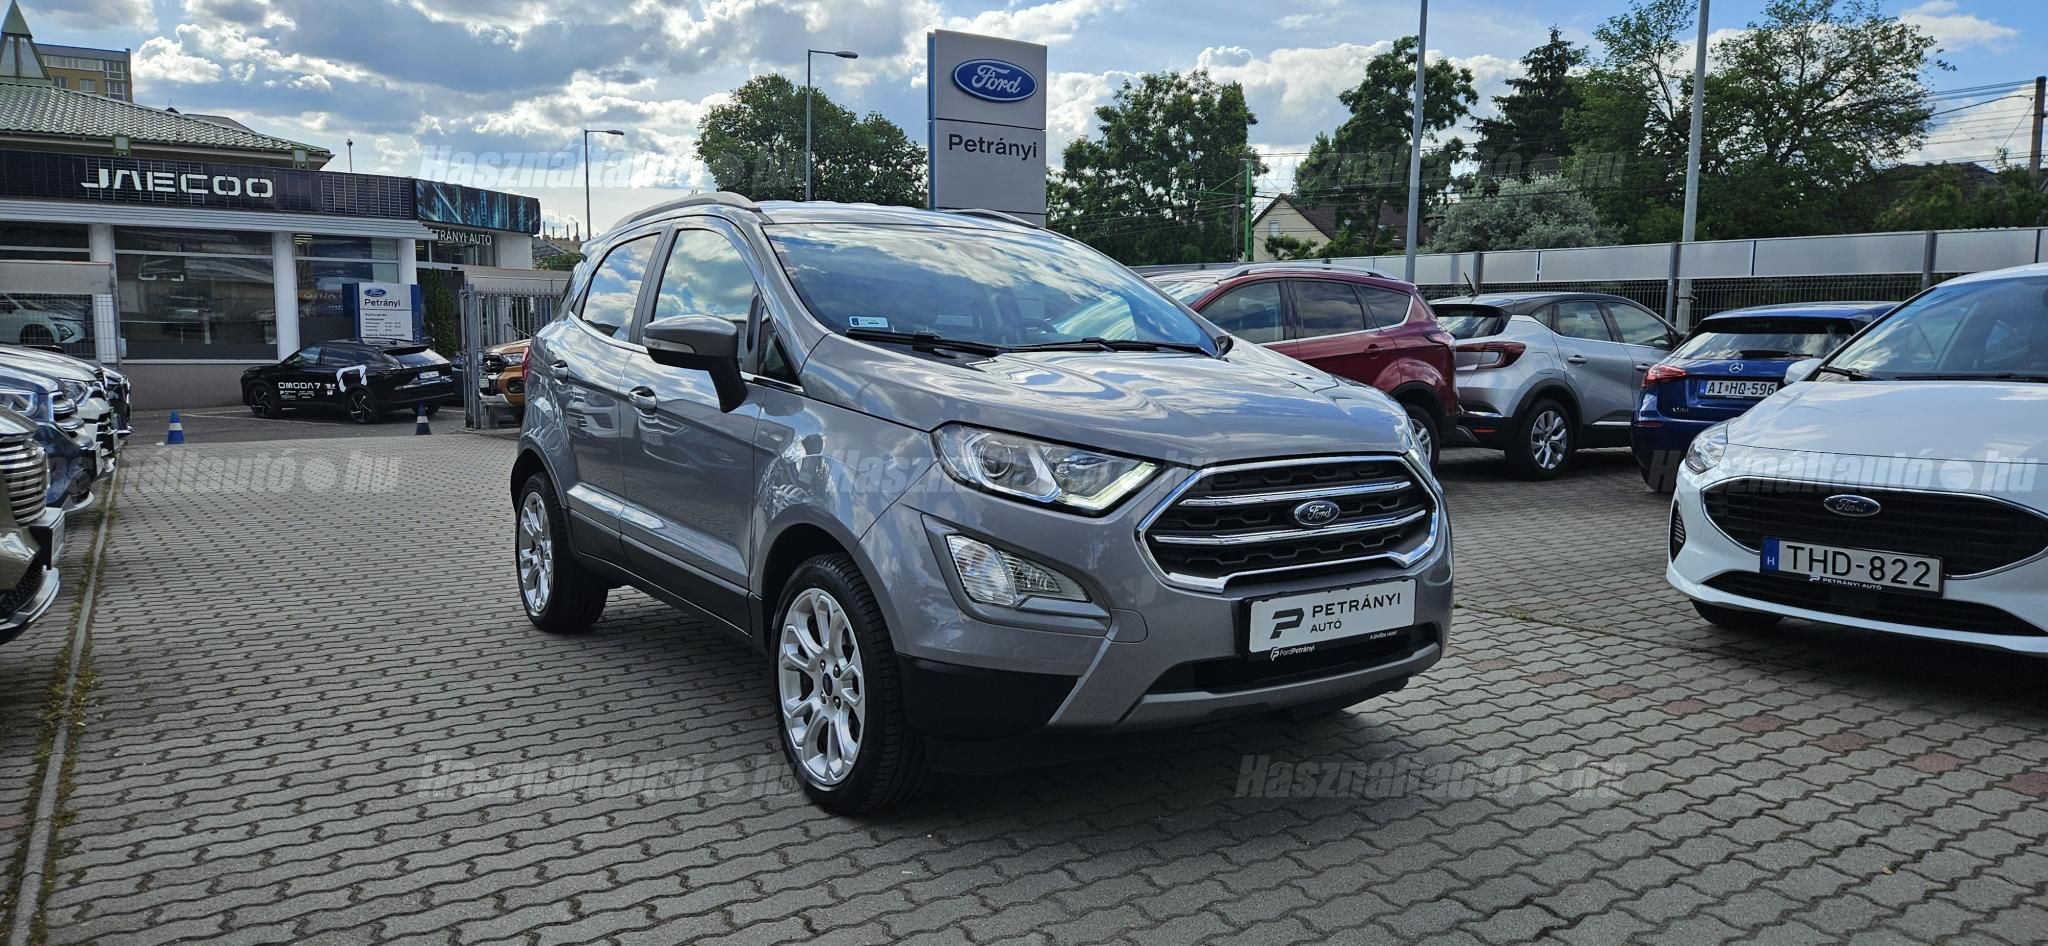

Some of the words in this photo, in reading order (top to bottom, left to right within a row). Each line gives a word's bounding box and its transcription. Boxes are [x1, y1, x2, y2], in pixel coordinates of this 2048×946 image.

[971, 64, 1022, 93] Ford
[948, 133, 1037, 161] Petrányi
[81, 168, 274, 198] JAECOO
[430, 226, 468, 244] TRÁNYI
[364, 298, 401, 308] Petrányi
[1308, 505, 1332, 520] Ford
[1767, 556, 1775, 566] H
[1786, 544, 1931, 588] THD-822
[1822, 576, 1861, 588] PETRÁNYI
[1861, 582, 1883, 591] AUTÓ
[1312, 593, 1401, 618] PETRÁNYI
[1310, 618, 1342, 633] AUTÓ
